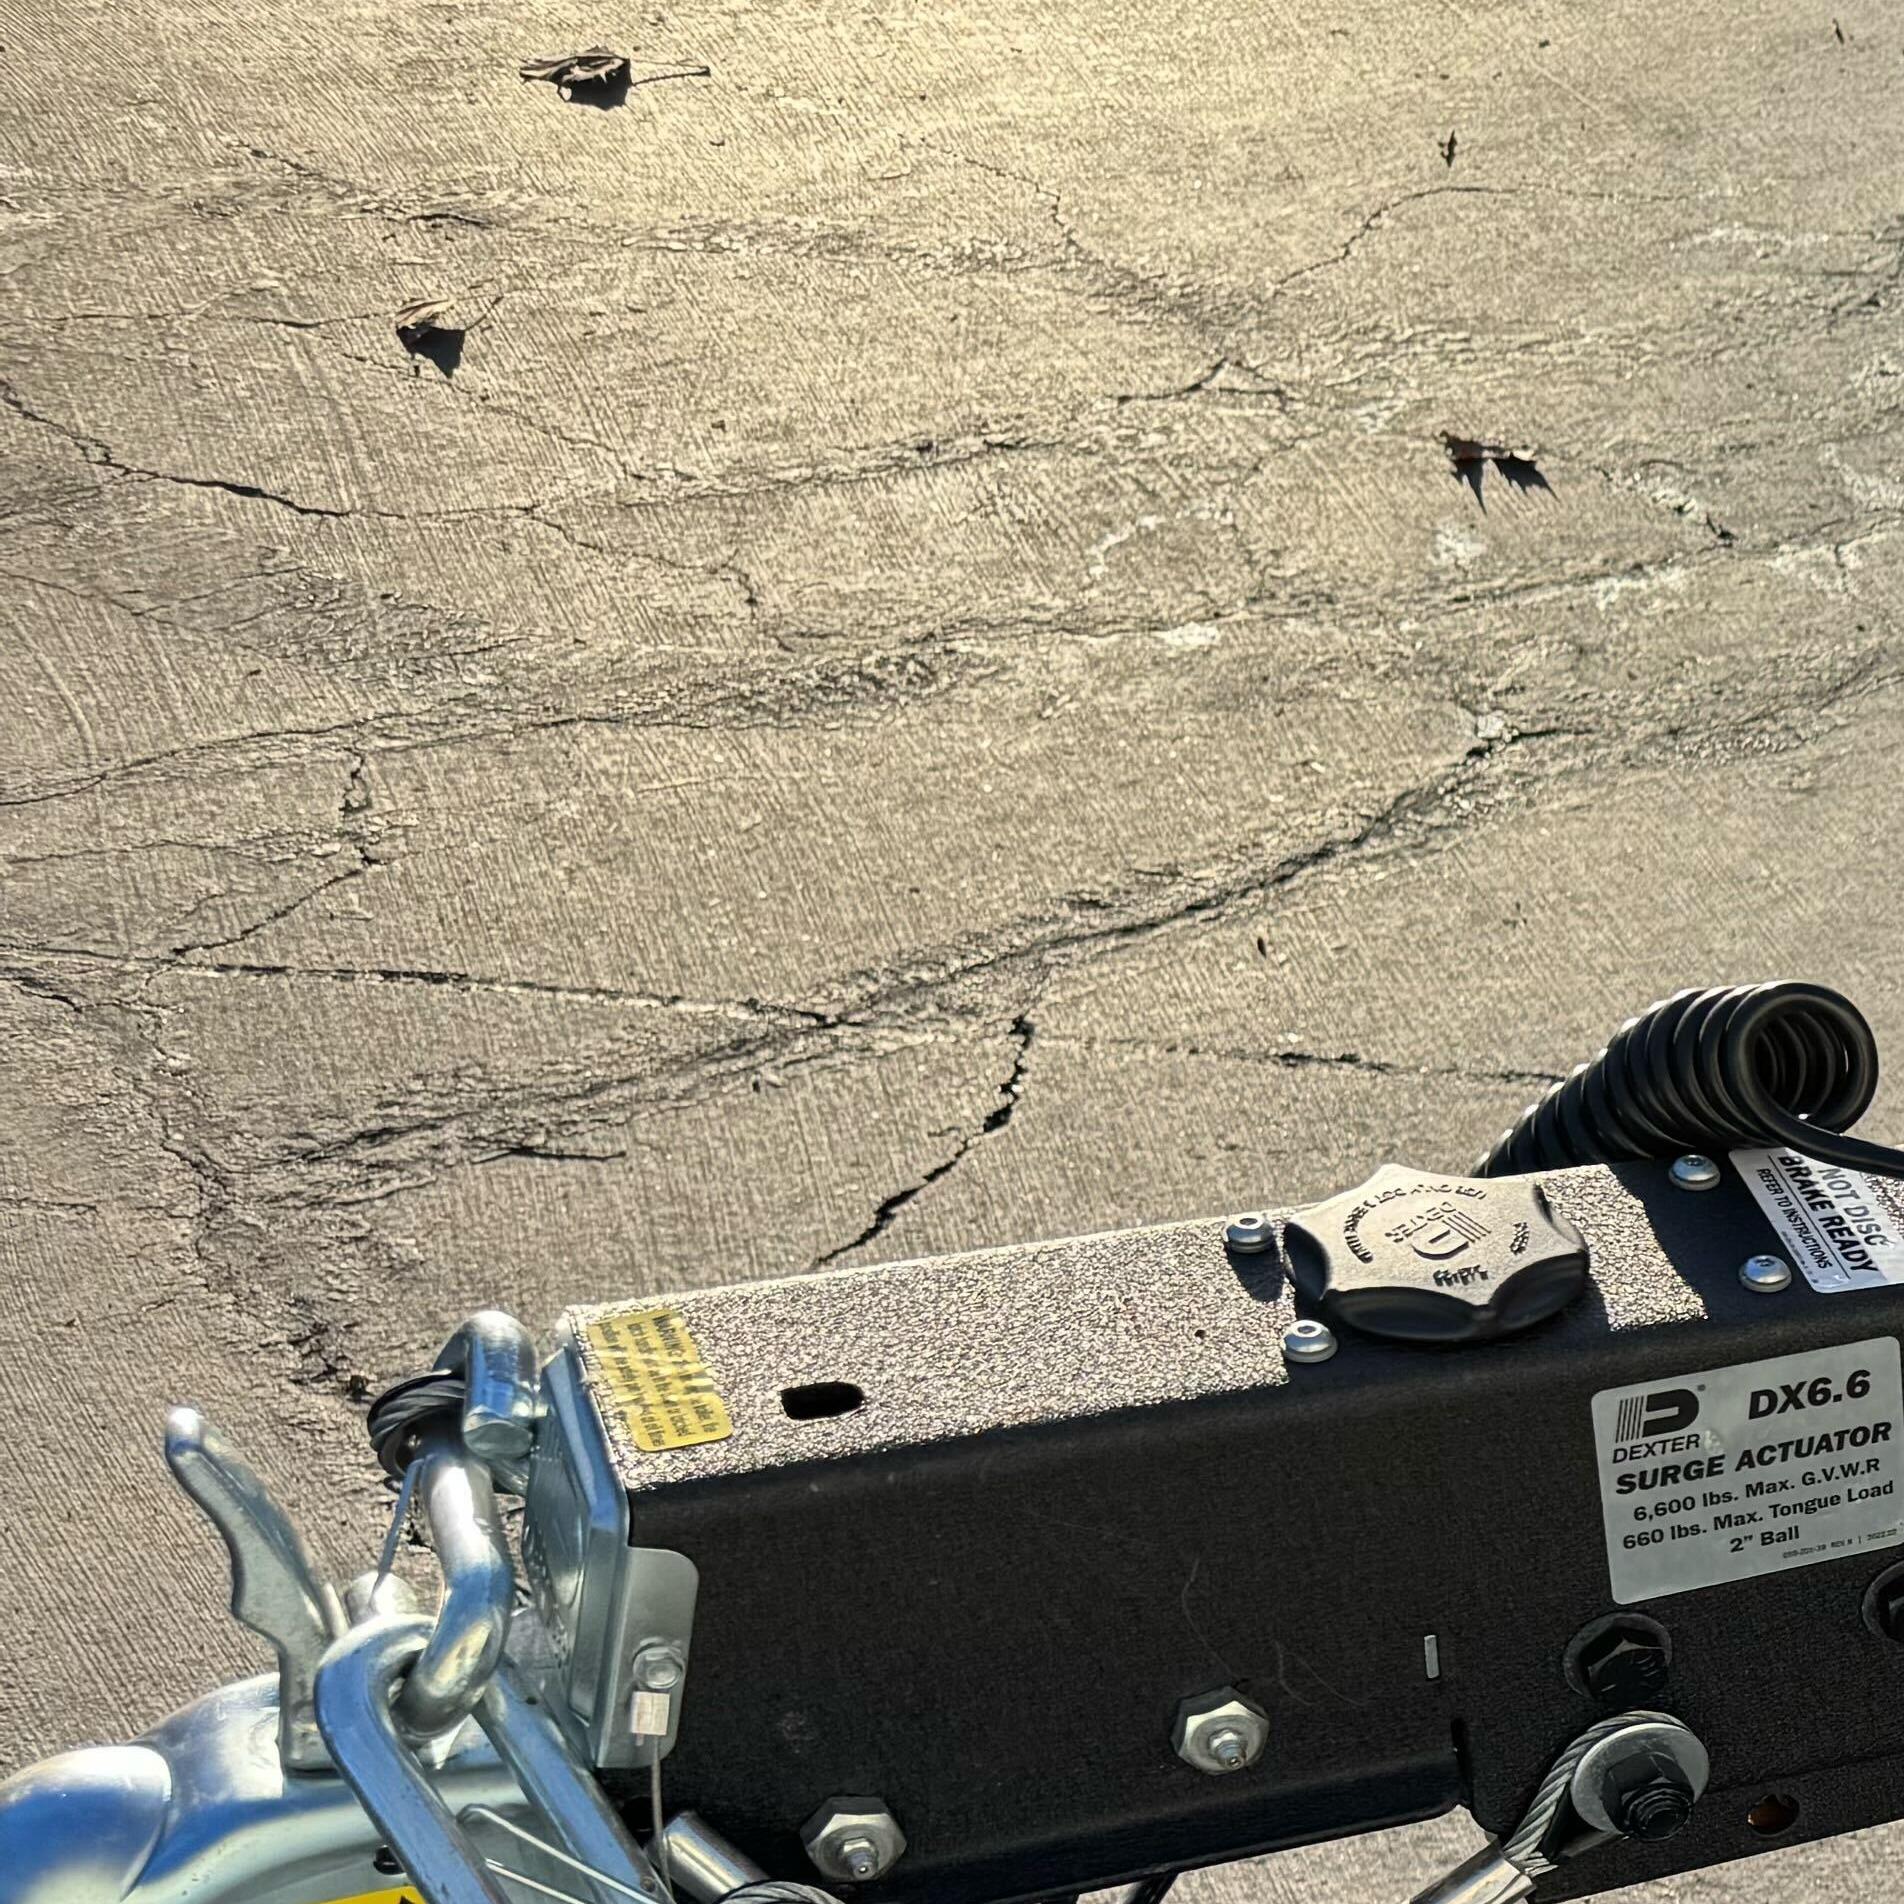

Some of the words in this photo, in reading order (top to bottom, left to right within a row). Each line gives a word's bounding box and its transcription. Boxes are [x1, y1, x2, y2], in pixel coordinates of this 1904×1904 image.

[1755, 1168, 1785, 1194] REFER
[1774, 1196, 1793, 1207] TO
[1817, 1167, 1860, 1202] NOT
[1843, 1205, 1890, 1246] DISC
[1777, 1154, 1836, 1212] BRAKE
[1816, 1214, 1878, 1274] READY
[1780, 1207, 1834, 1268] INSTRUCTIONS
[1747, 1367, 1872, 1420] DX6.6
[1612, 1432, 1700, 1463] DEXTER
[1615, 1454, 1726, 1495] SURGE
[1734, 1420, 1892, 1472] ACTUATOR
[1622, 1527, 1664, 1550] 660
[1670, 1518, 1707, 1540] lbs.
[1713, 1506, 1762, 1530] Max.
[1768, 1490, 1840, 1522] Tongue
[1846, 1479, 1893, 1502] Load
[1633, 1495, 1695, 1523] 6,600
[1702, 1486, 1738, 1507] lbs.
[1745, 1474, 1795, 1498] Max.
[1801, 1456, 1880, 1487] G.V.W.R
[1760, 1524, 1799, 1546] Ball
